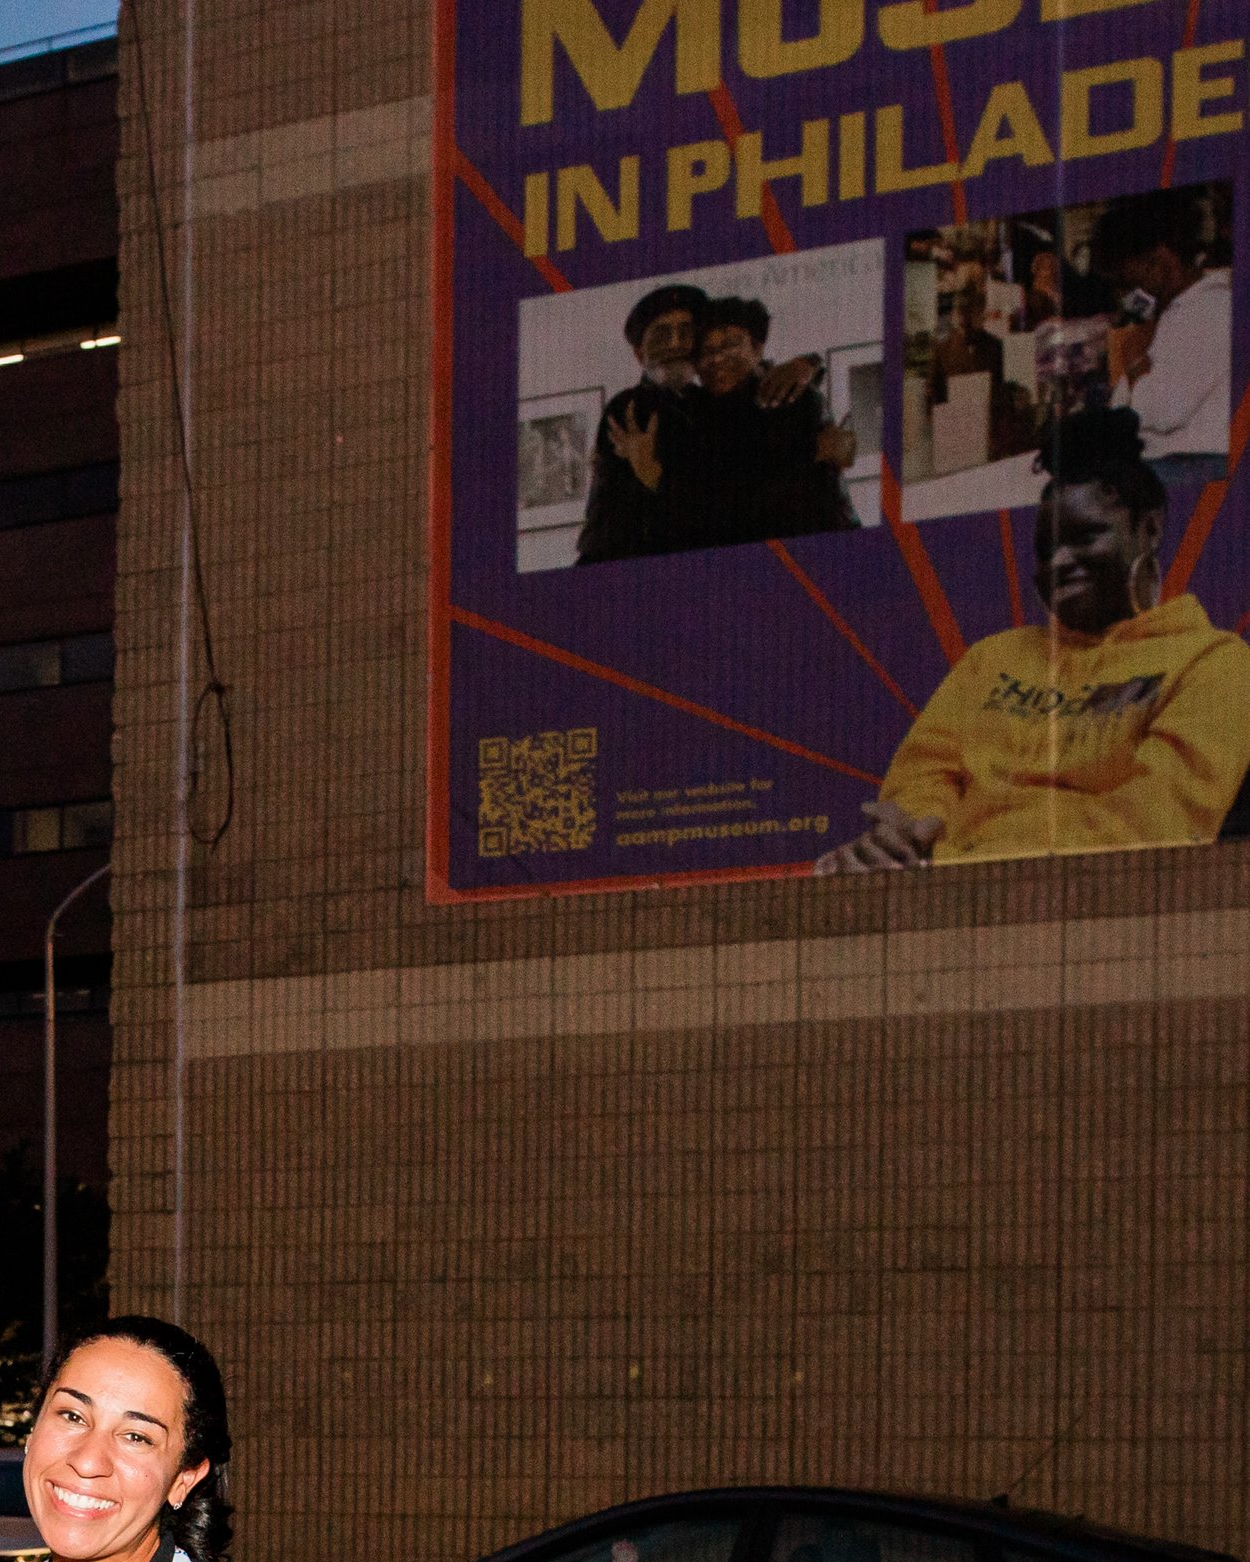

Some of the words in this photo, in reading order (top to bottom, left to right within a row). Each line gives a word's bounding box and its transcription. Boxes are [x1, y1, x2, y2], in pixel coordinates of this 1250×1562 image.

[520, 0, 1152, 127] MU
[524, 155, 640, 258] IN
[666, 39, 1245, 233] PHILADE
[616, 814, 829, 848] aampmuseum.org
